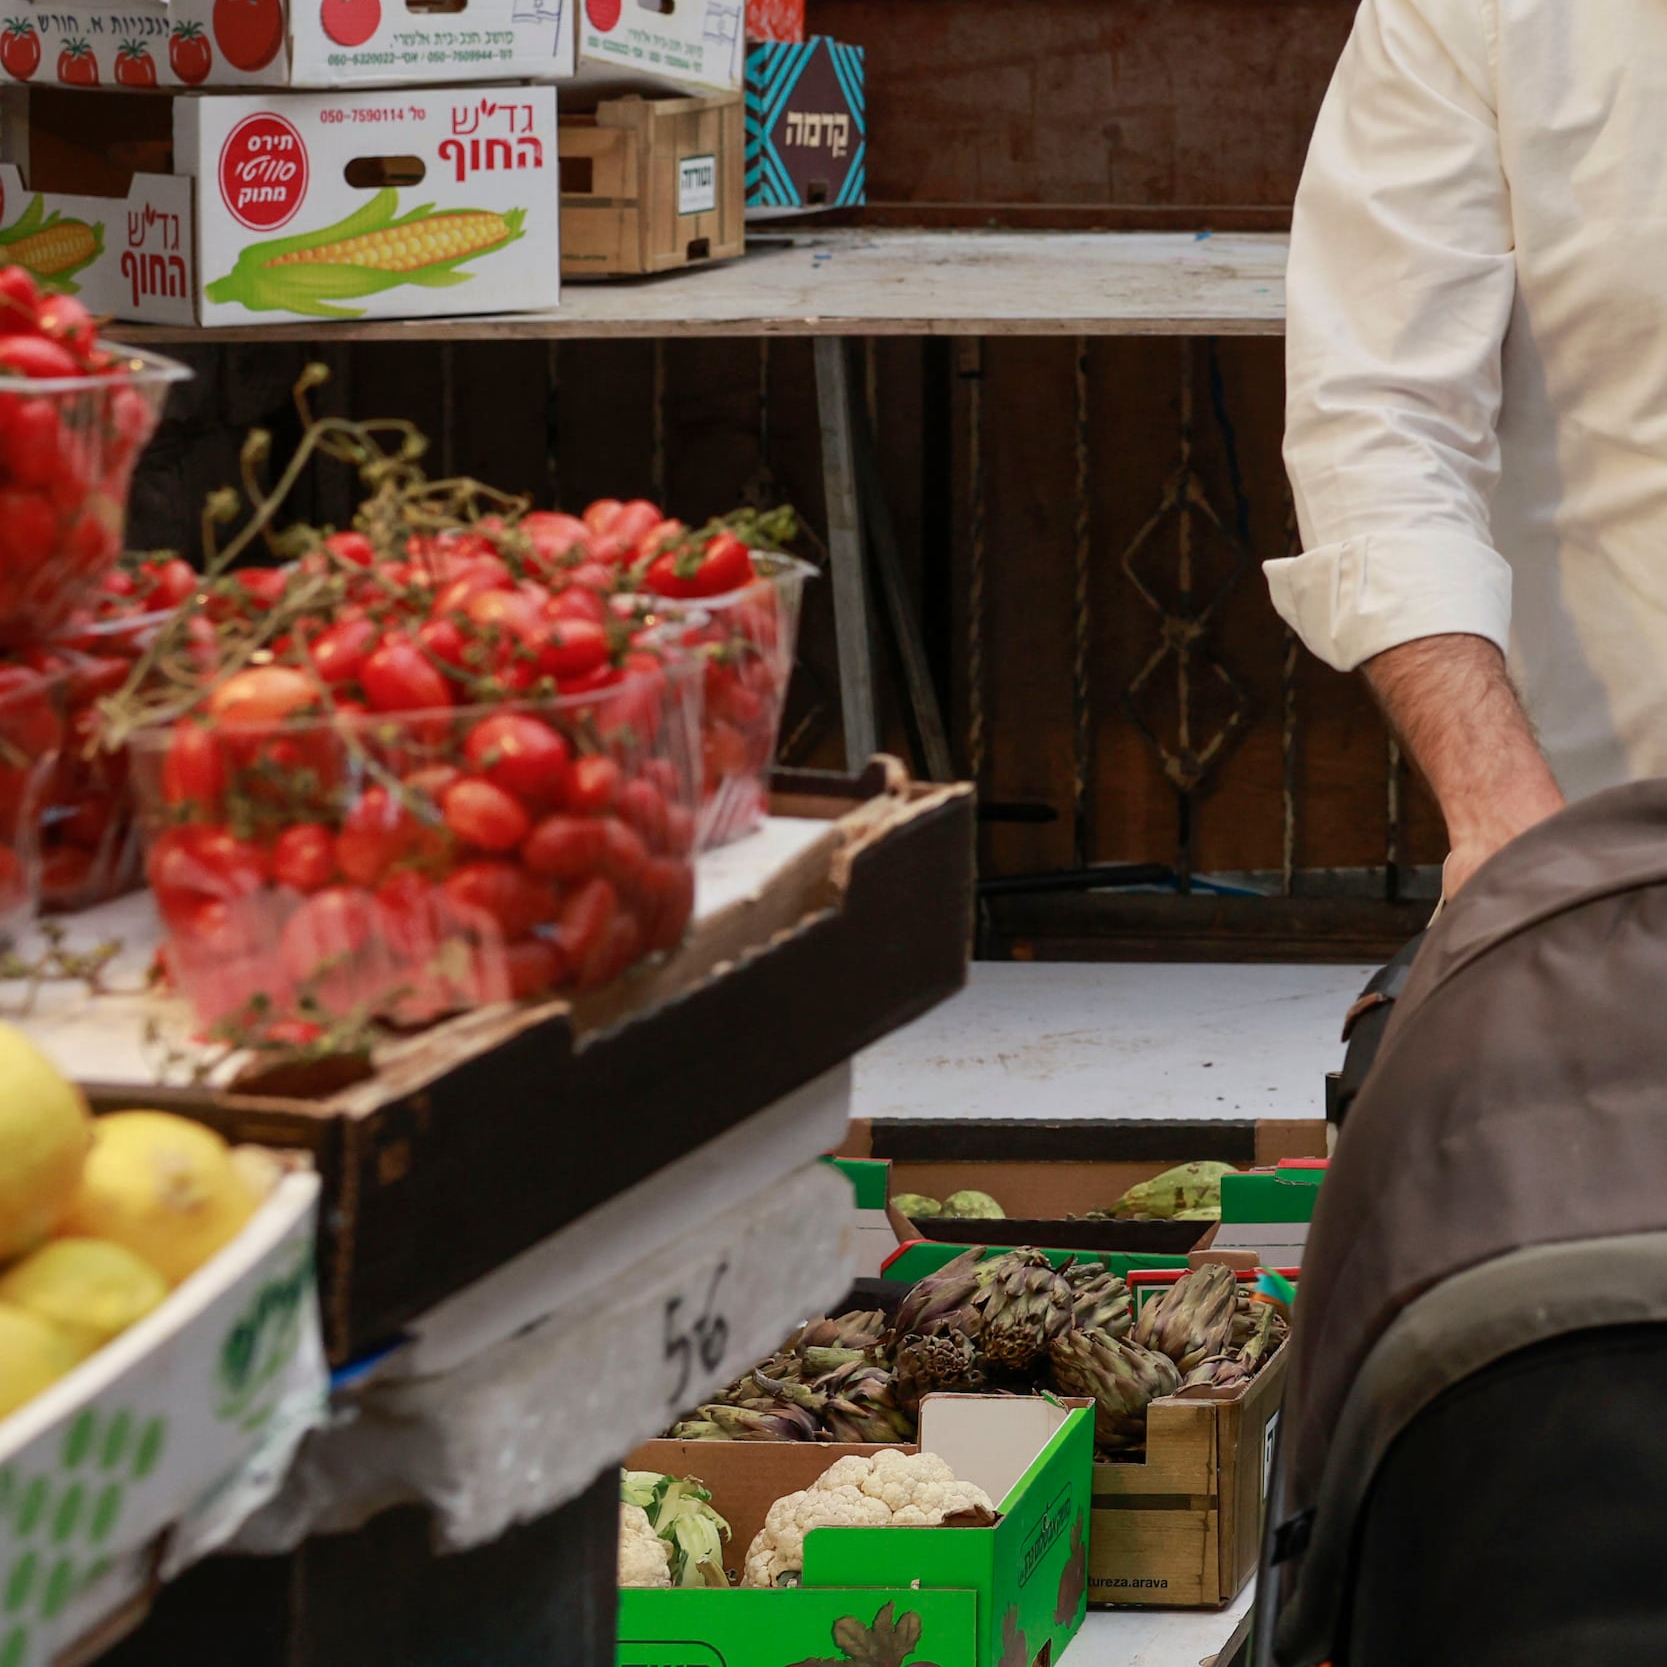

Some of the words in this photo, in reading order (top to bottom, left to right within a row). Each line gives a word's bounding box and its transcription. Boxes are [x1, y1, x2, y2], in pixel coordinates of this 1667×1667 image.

[320, 107, 404, 125] 050-7590114
[248, 134, 293, 151] תירס
[438, 136, 543, 182] החוף
[238, 187, 287, 209] מתוק
[121, 250, 187, 308] החוף
